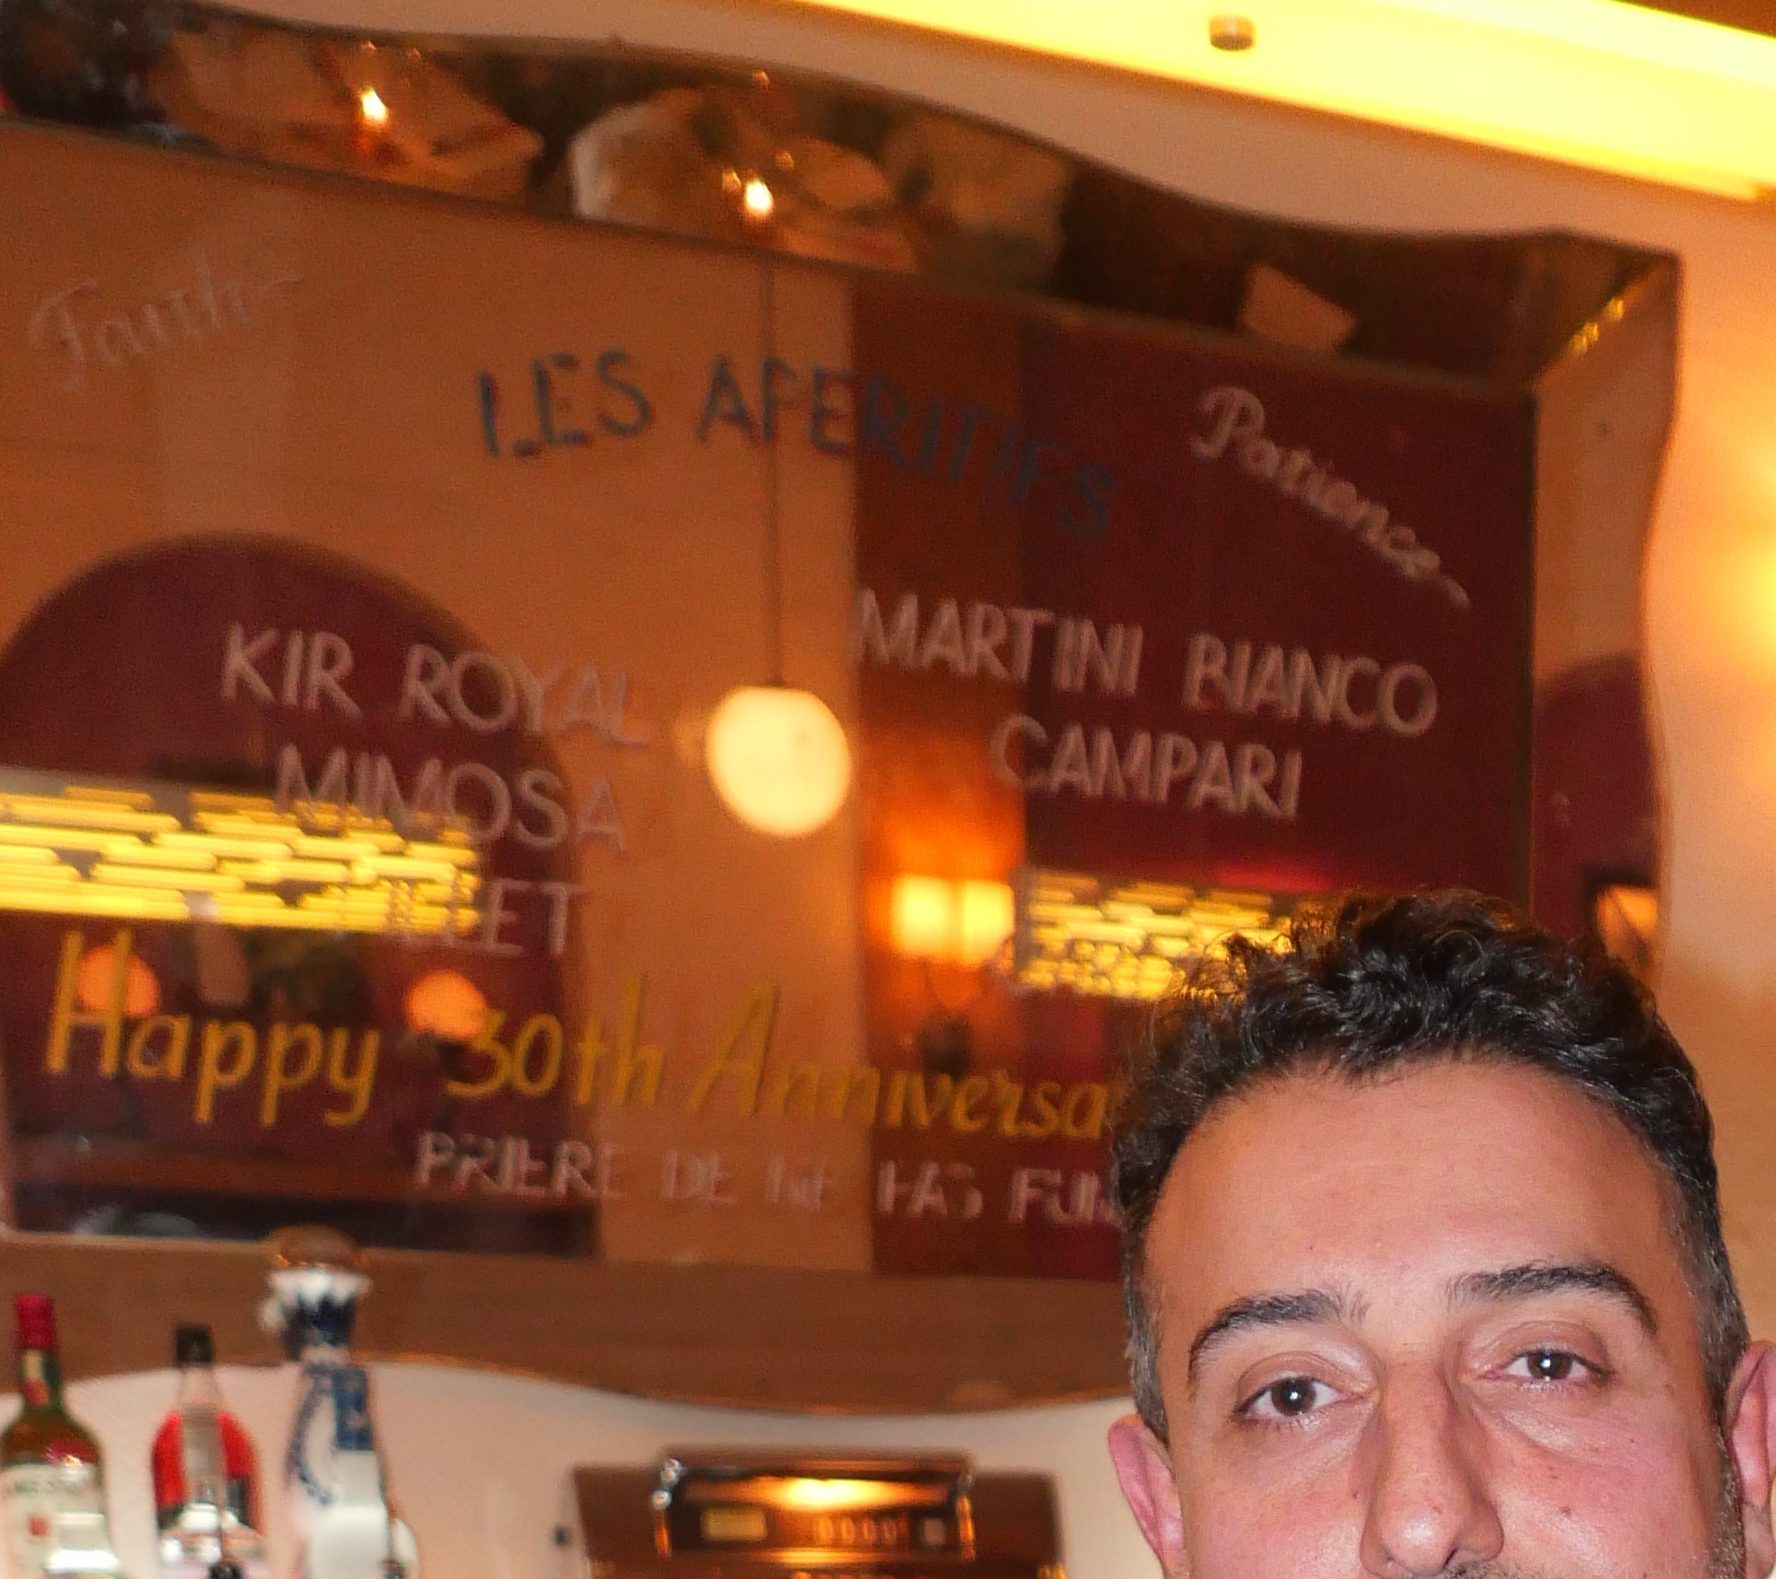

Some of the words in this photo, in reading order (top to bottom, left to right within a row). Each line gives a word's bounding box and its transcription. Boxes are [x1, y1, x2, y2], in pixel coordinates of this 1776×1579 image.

[477, 349, 654, 459] LES
[220, 622, 362, 722] KIR
[402, 642, 648, 752] ROYAL
[852, 587, 1144, 696] MARTINI
[1183, 633, 1440, 737] BIANCO
[276, 741, 627, 852] MIMOSA
[991, 713, 1303, 821] CAMPARI
[43, 927, 382, 1128] Happy
[689, 978, 1120, 1140] Anniversa
